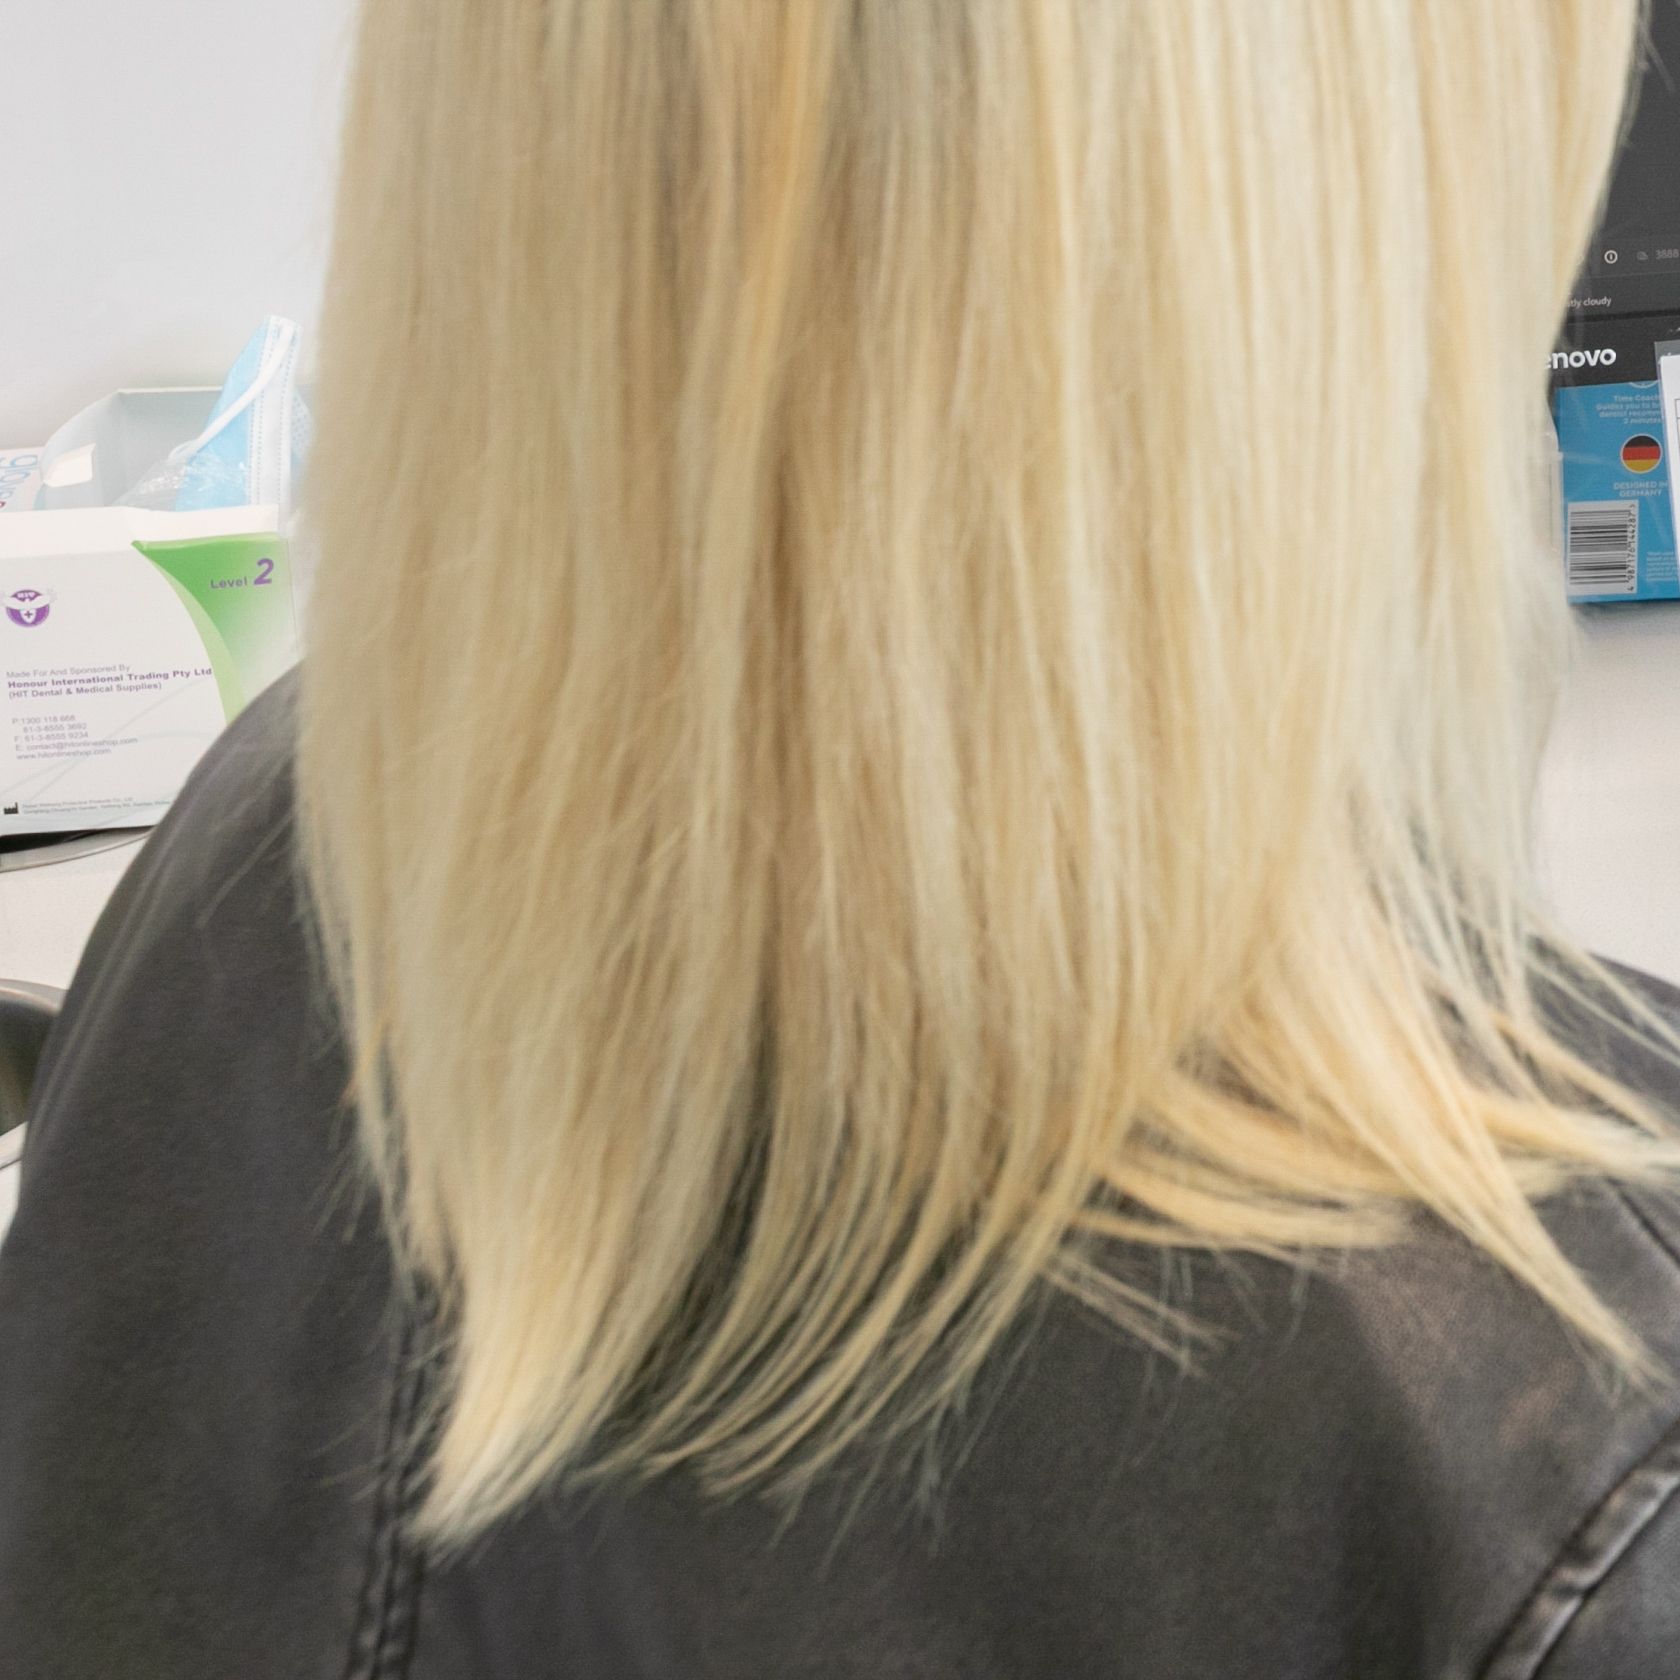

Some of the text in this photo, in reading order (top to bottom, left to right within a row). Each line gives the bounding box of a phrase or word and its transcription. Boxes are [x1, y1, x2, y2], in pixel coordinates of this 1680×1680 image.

[1583, 297, 1611, 307] cloudy
[1548, 349, 1616, 369] novo
[210, 558, 274, 589] Level 2
[8, 677, 48, 688] Honour
[52, 674, 124, 686] International
[127, 671, 169, 682] Trading
[173, 669, 191, 679] Pty
[9, 681, 162, 699] (HIT Dental & Medical Supplies)
